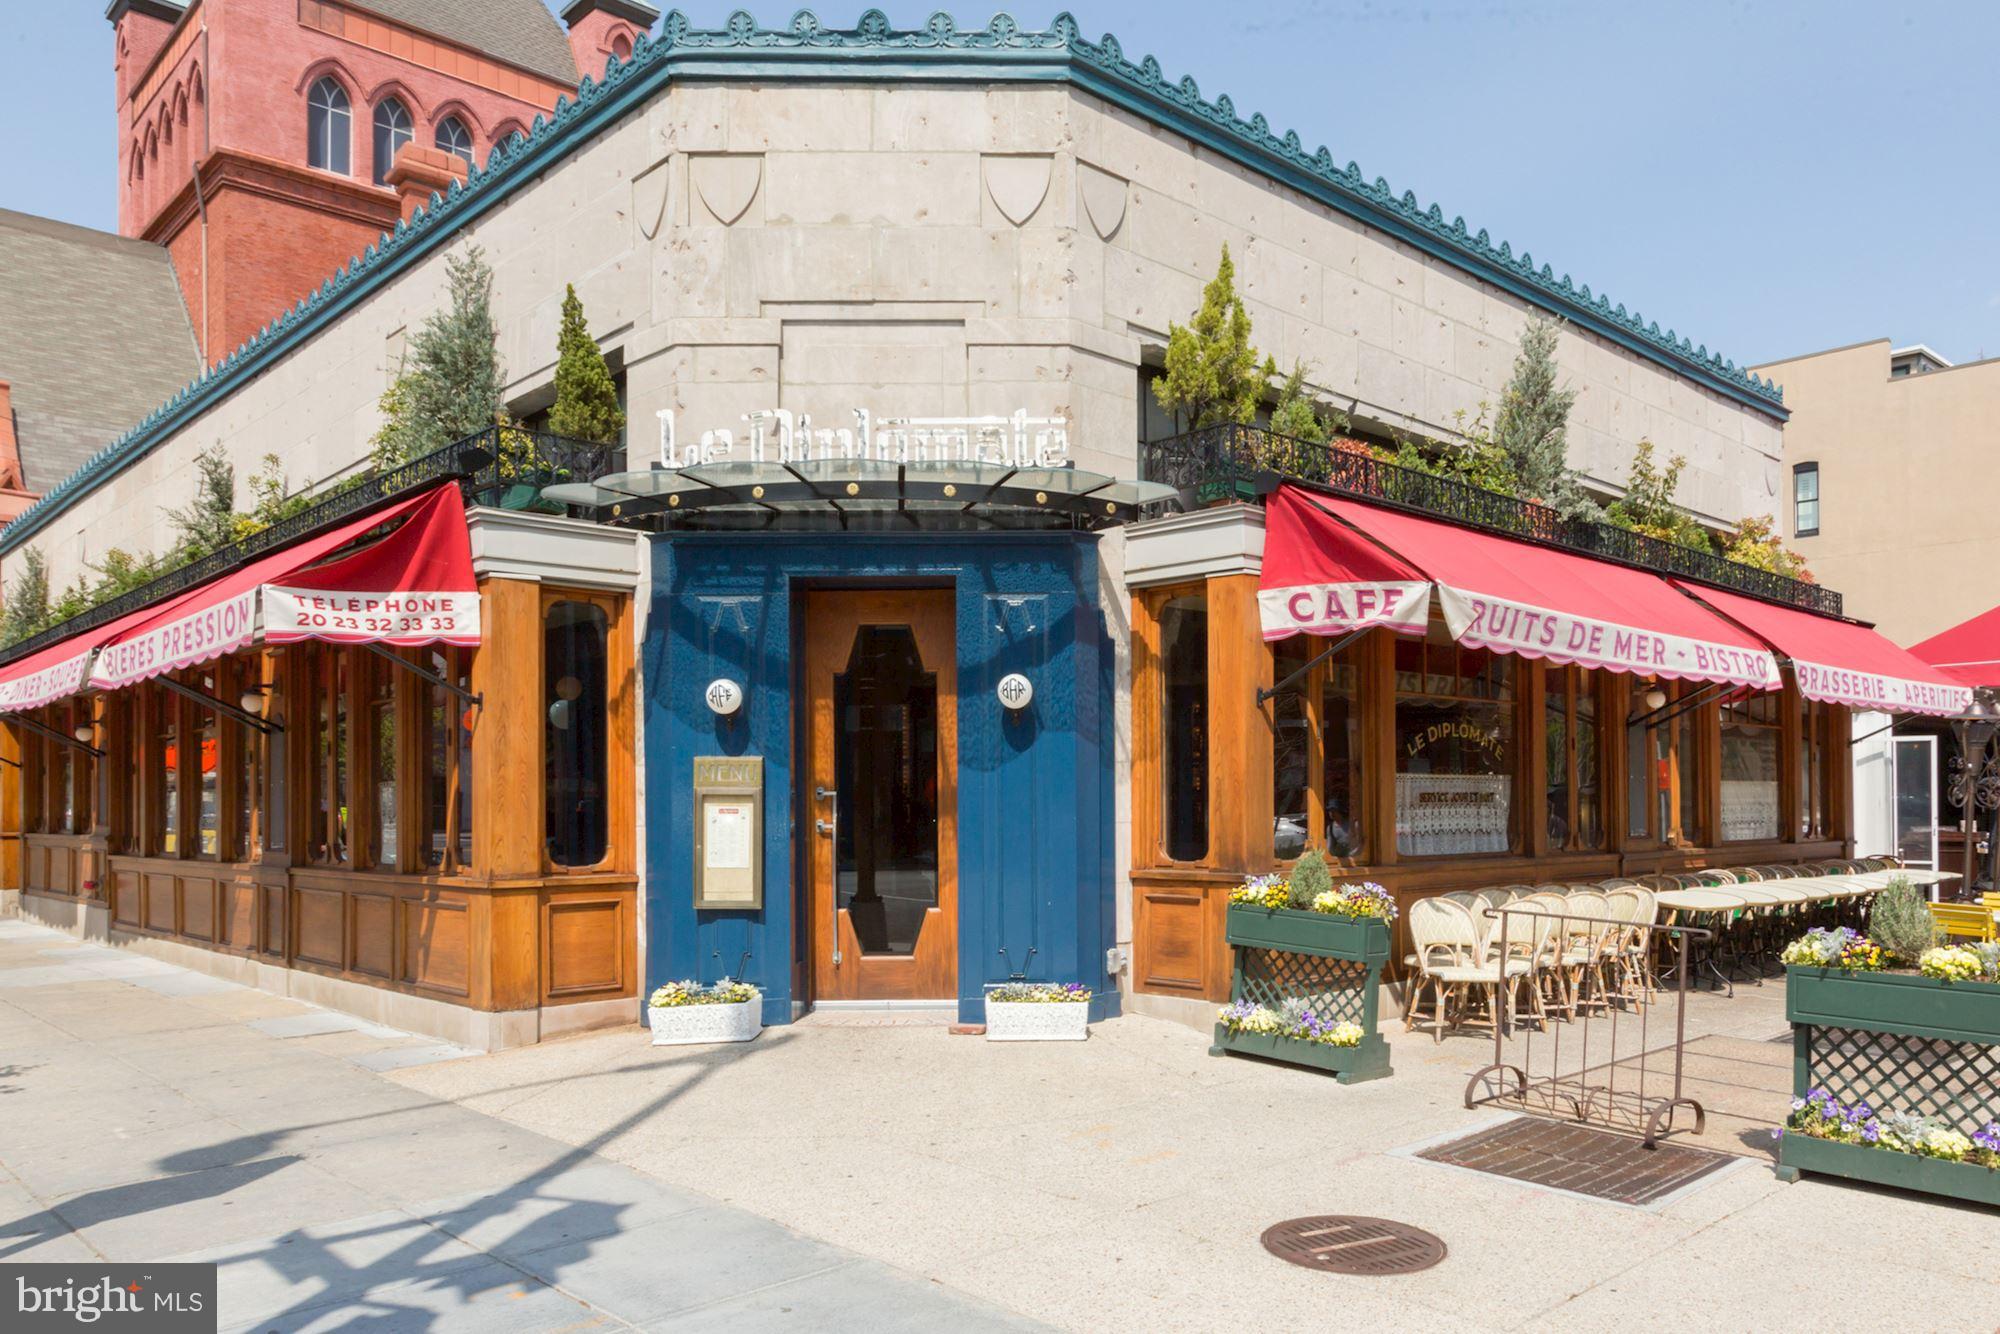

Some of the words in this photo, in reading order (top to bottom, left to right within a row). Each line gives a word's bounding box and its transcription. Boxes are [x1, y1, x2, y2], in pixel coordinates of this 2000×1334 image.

[656, 408, 733, 470] Le
[162, 598, 249, 660] PRESSION
[297, 612, 327, 627] 20
[333, 616, 359, 630] 23
[366, 618, 392, 632] 32
[400, 617, 424, 631] 33
[431, 617, 455, 630] 33
[1470, 598, 1558, 646] RUITS
[1567, 620, 1604, 654] DE
[1612, 630, 1666, 665] MER
[1001, 678, 1025, 703] BAR
[1799, 664, 1886, 700] BRASSERIE
[1407, 732, 1426, 757] LE
[1427, 722, 1505, 761] DIPLOMATE
[700, 764, 757, 783] MENU
